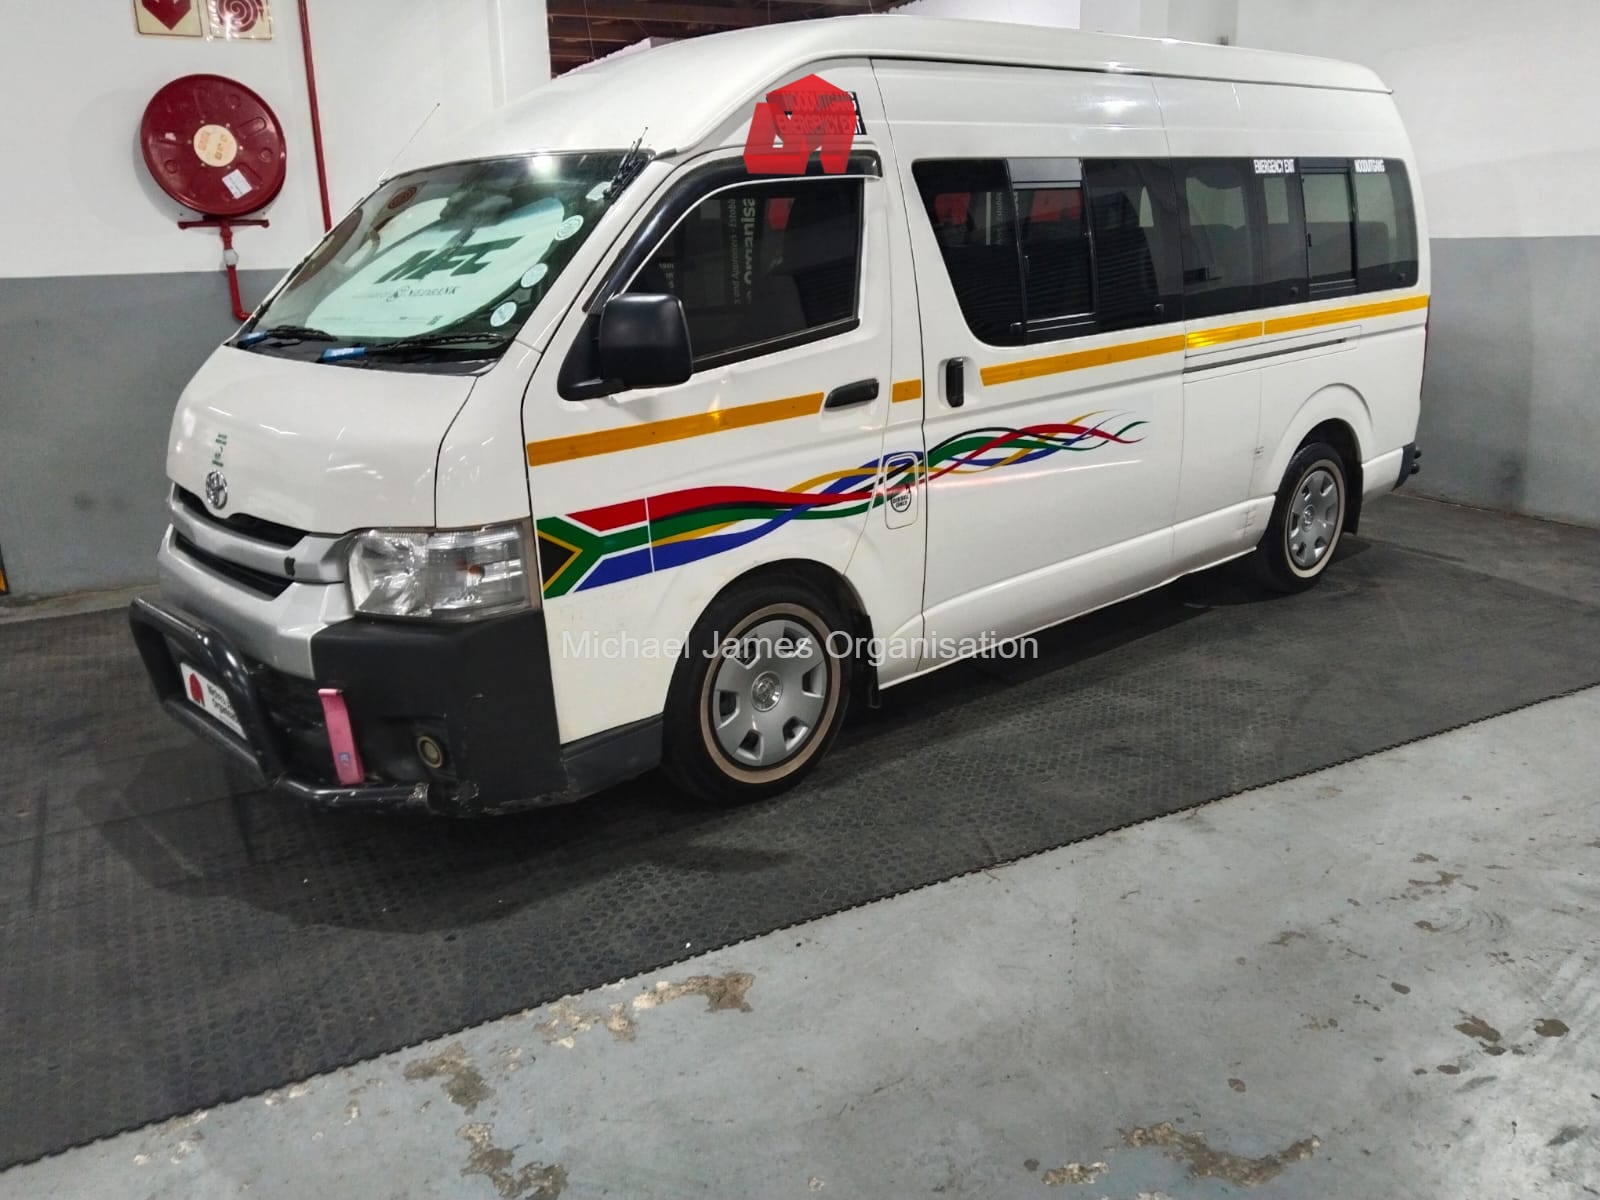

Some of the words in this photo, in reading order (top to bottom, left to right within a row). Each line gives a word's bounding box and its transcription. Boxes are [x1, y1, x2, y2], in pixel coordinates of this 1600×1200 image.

[775, 114, 840, 134] EMERGENCY
[839, 114, 862, 134] EXIT
[373, 236, 526, 284] MFC
[892, 495, 909, 504] DIESEL
